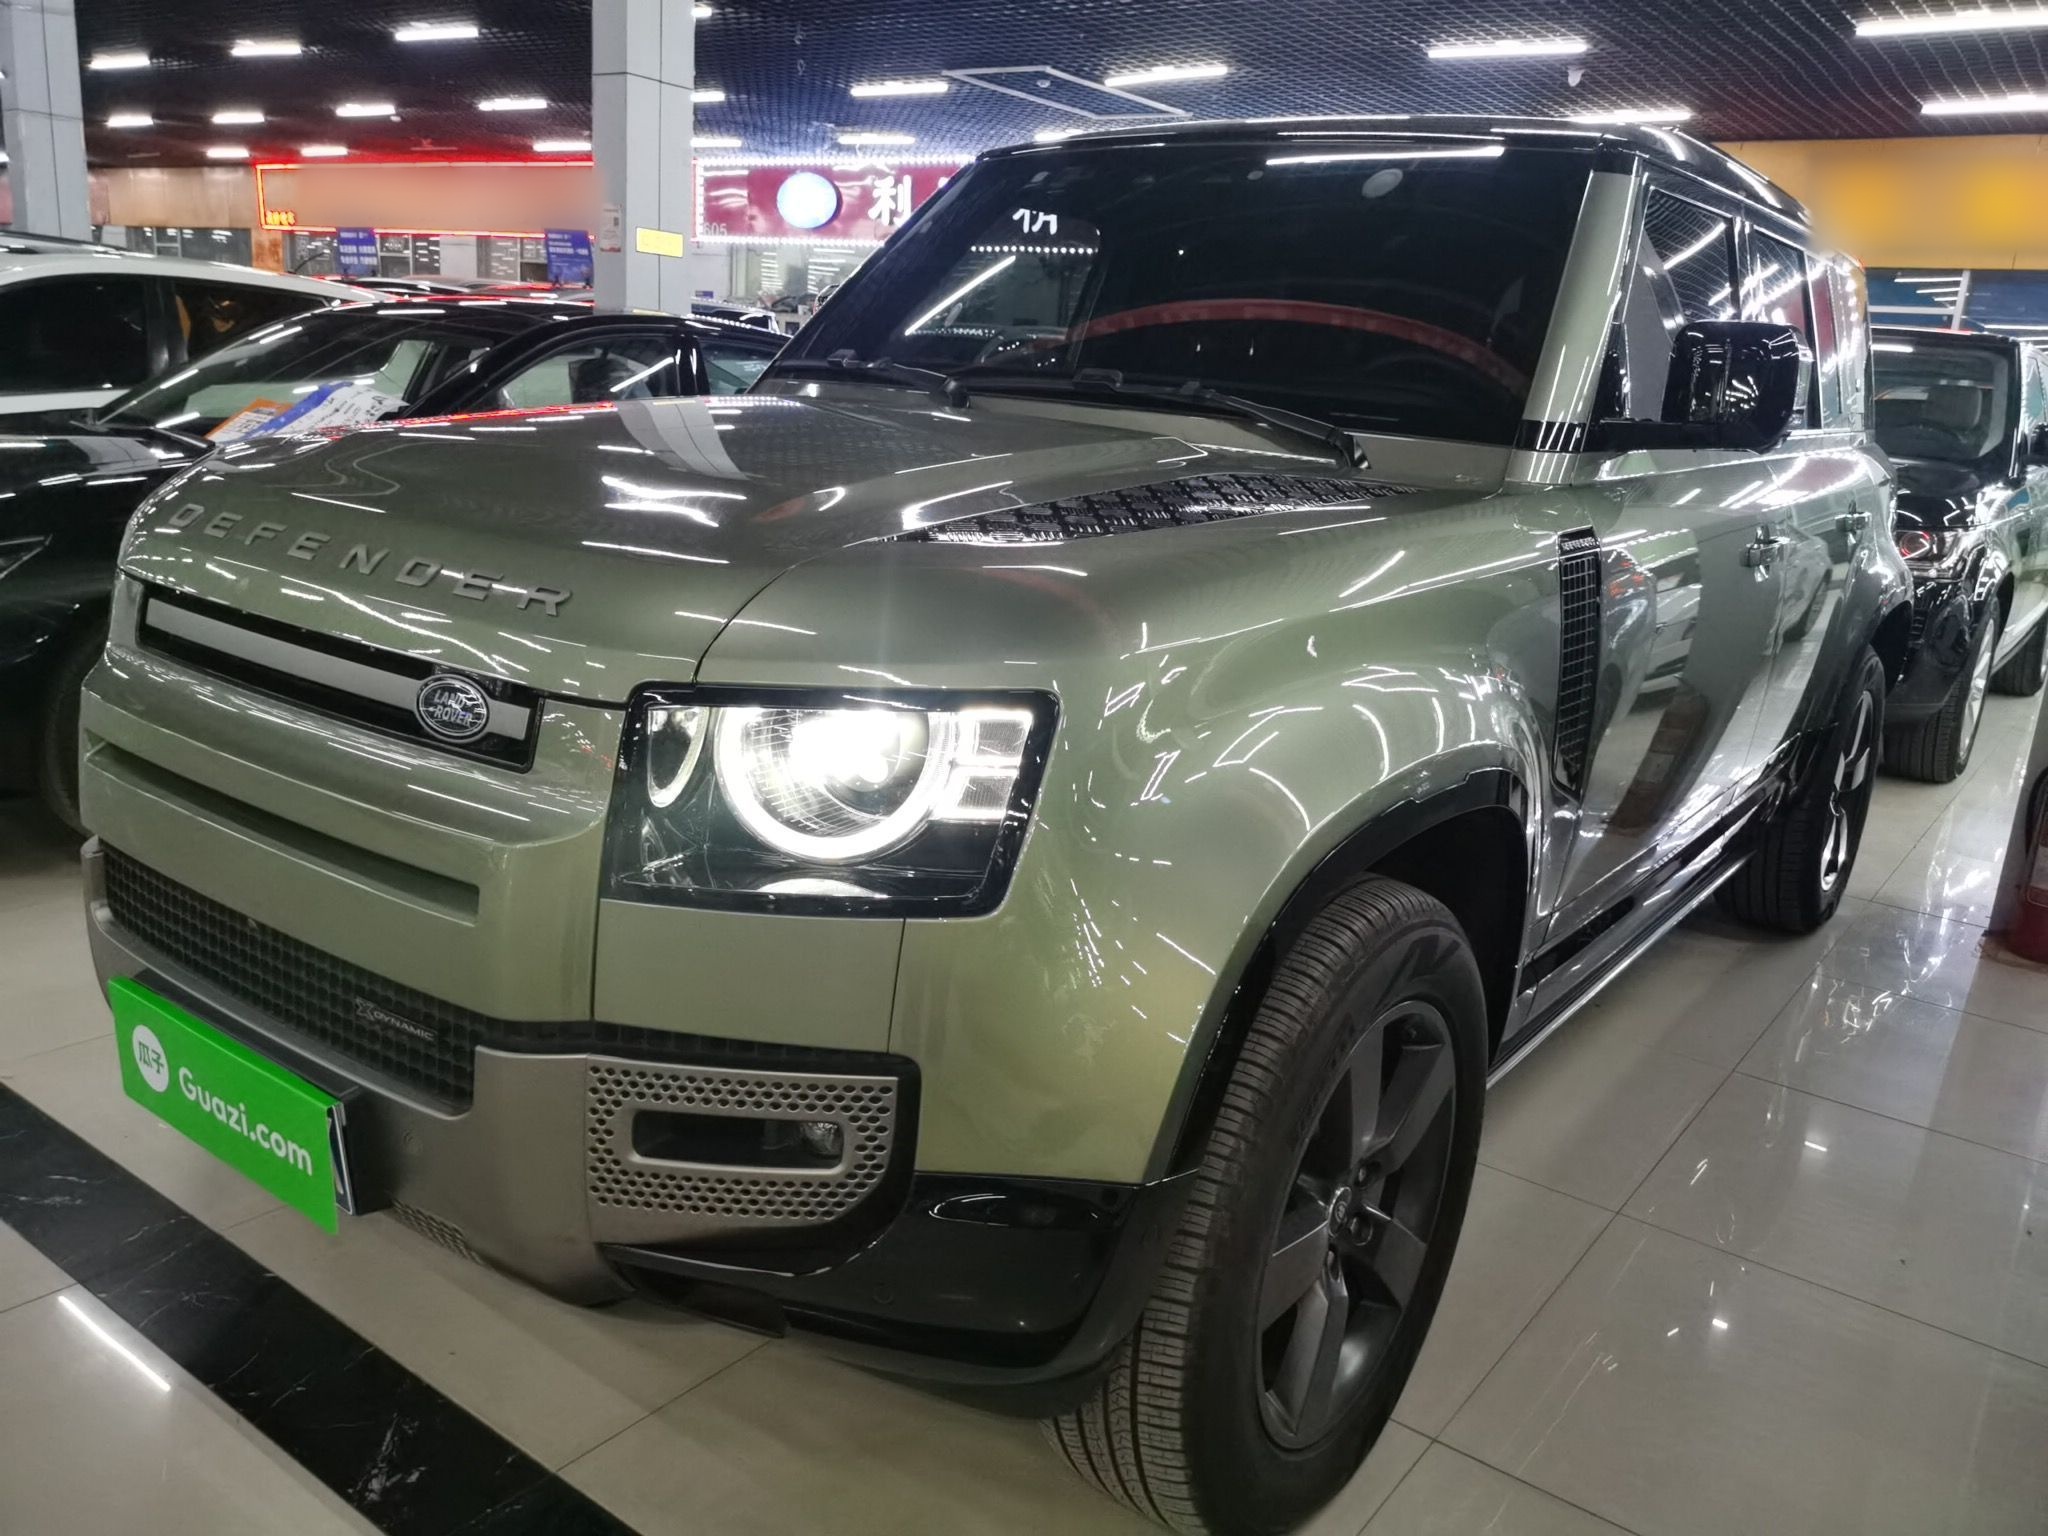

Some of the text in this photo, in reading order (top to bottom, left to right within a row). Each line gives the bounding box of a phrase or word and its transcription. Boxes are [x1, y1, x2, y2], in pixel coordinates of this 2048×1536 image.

[868, 174, 913, 227] 利
[168, 503, 571, 617] DEFENDER
[434, 689, 466, 709] LAND
[434, 705, 473, 728] ROVER
[137, 1040, 165, 1075] 瓜子
[178, 1066, 313, 1176] Guazi.com
